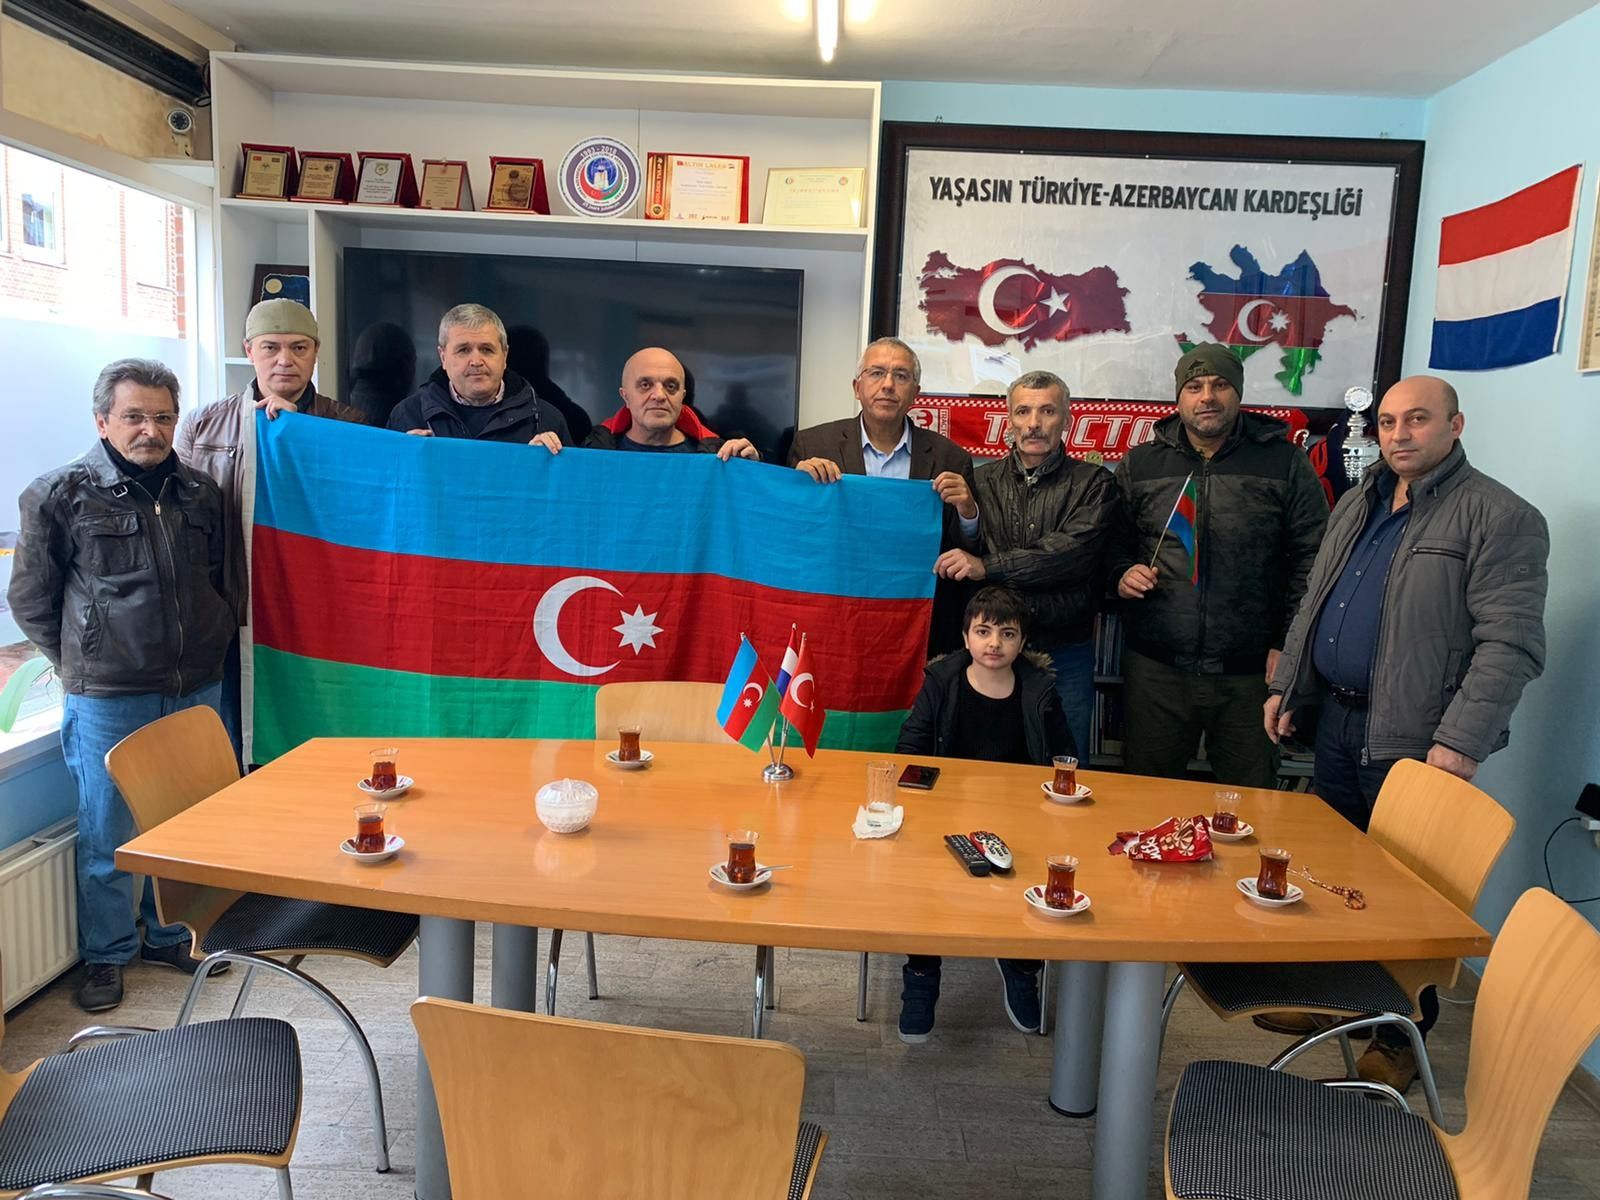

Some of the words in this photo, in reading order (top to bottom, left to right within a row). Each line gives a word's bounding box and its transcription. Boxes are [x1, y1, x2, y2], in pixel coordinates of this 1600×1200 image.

[929, 176, 1012, 207] YAŞASIN
[1019, 176, 1238, 212] TÜRKİYE-AZERBAYCAN
[1243, 187, 1363, 221] KARDEŞLİĞİ
